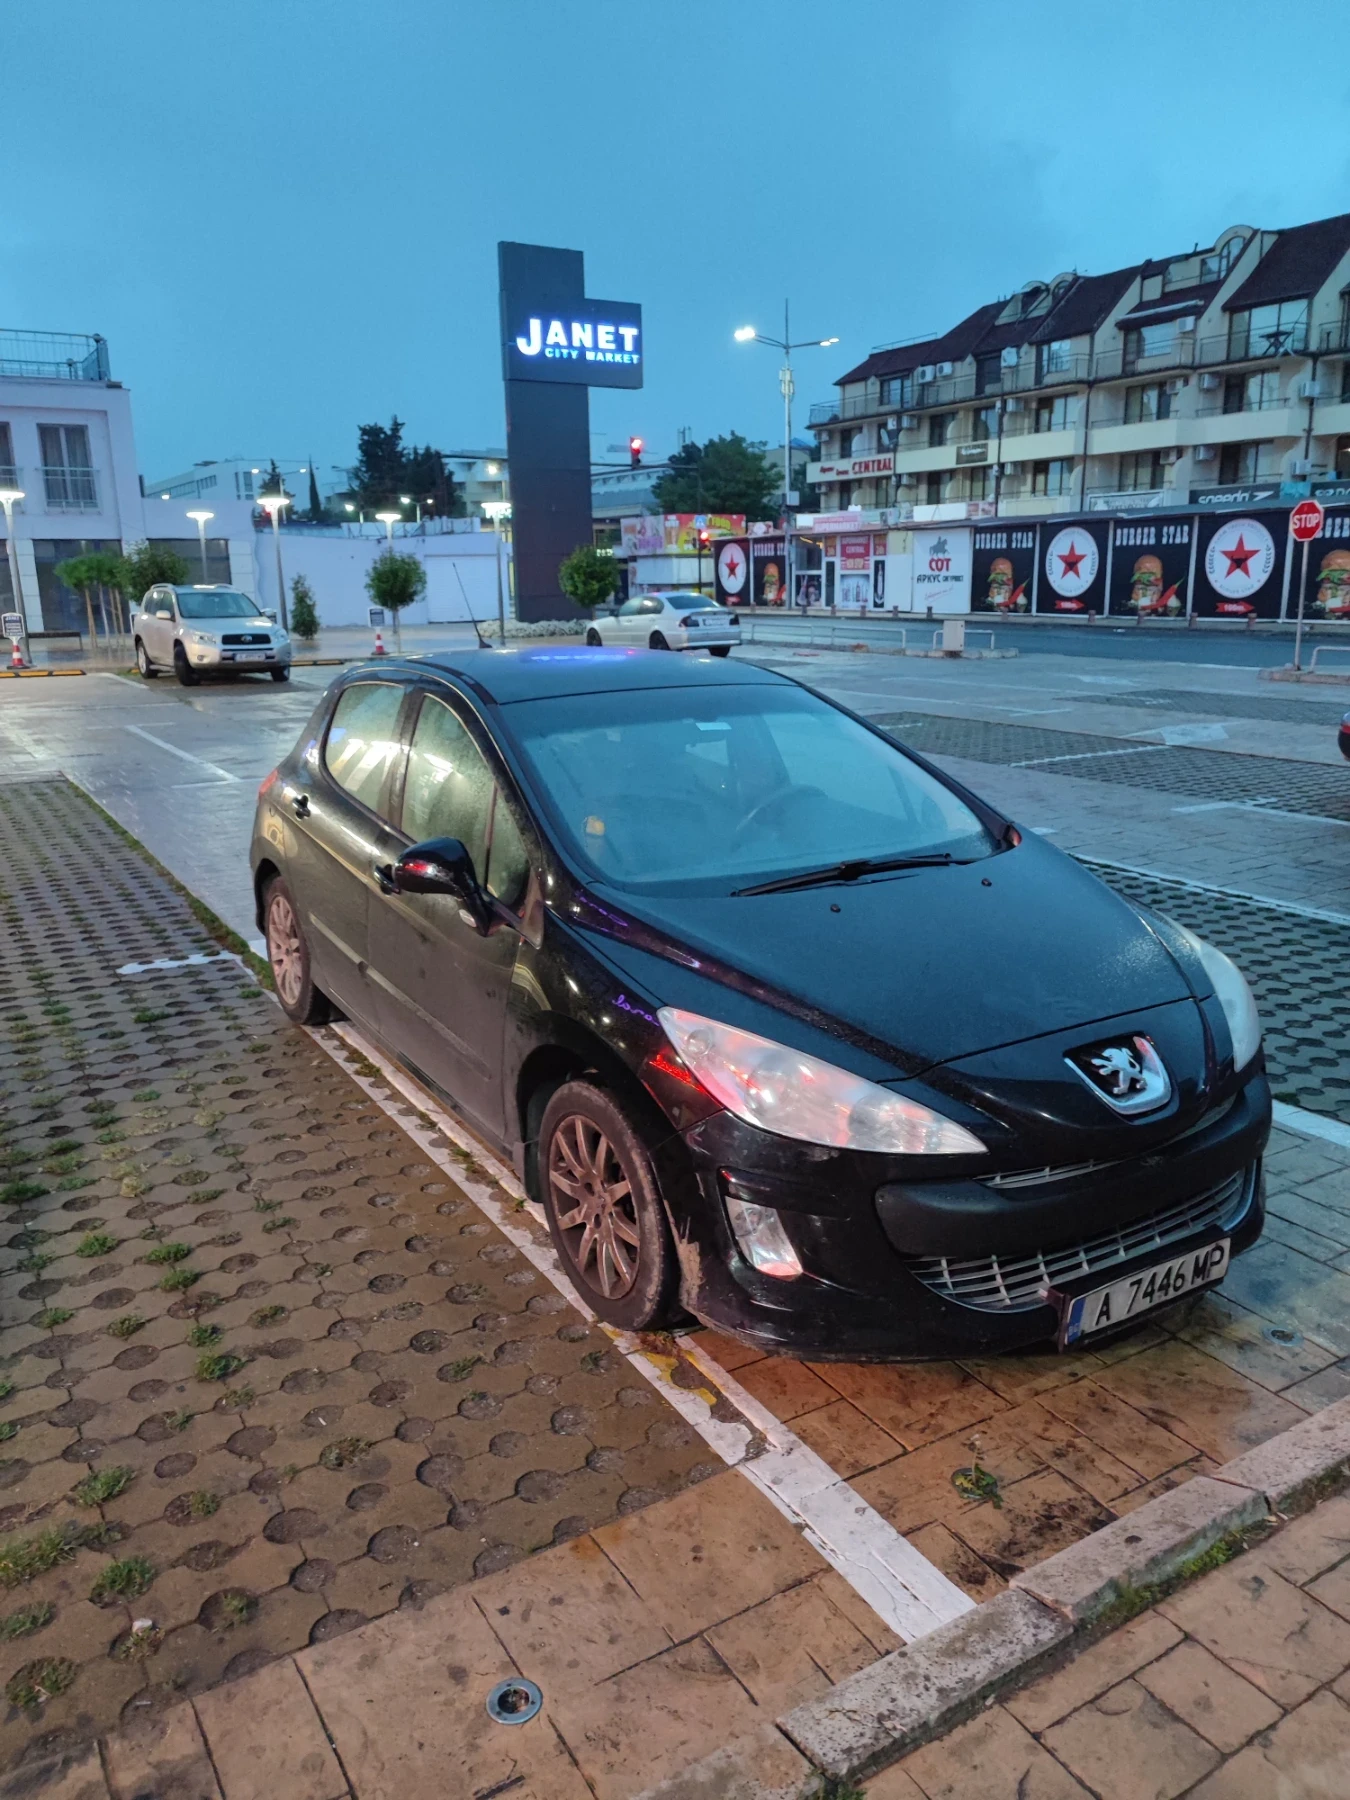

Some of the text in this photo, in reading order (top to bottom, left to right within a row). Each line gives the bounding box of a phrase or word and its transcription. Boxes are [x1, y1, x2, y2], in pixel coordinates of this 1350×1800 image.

[516, 318, 639, 355] JANET
[544, 347, 640, 364] CITY MARKET
[852, 458, 892, 474] CENTRAL
[1293, 513, 1320, 529] STOP
[976, 531, 1033, 549] BURGER STAR
[1115, 525, 1189, 546] BURGER STAR
[1094, 1243, 1225, 1326] A 7446 MP
